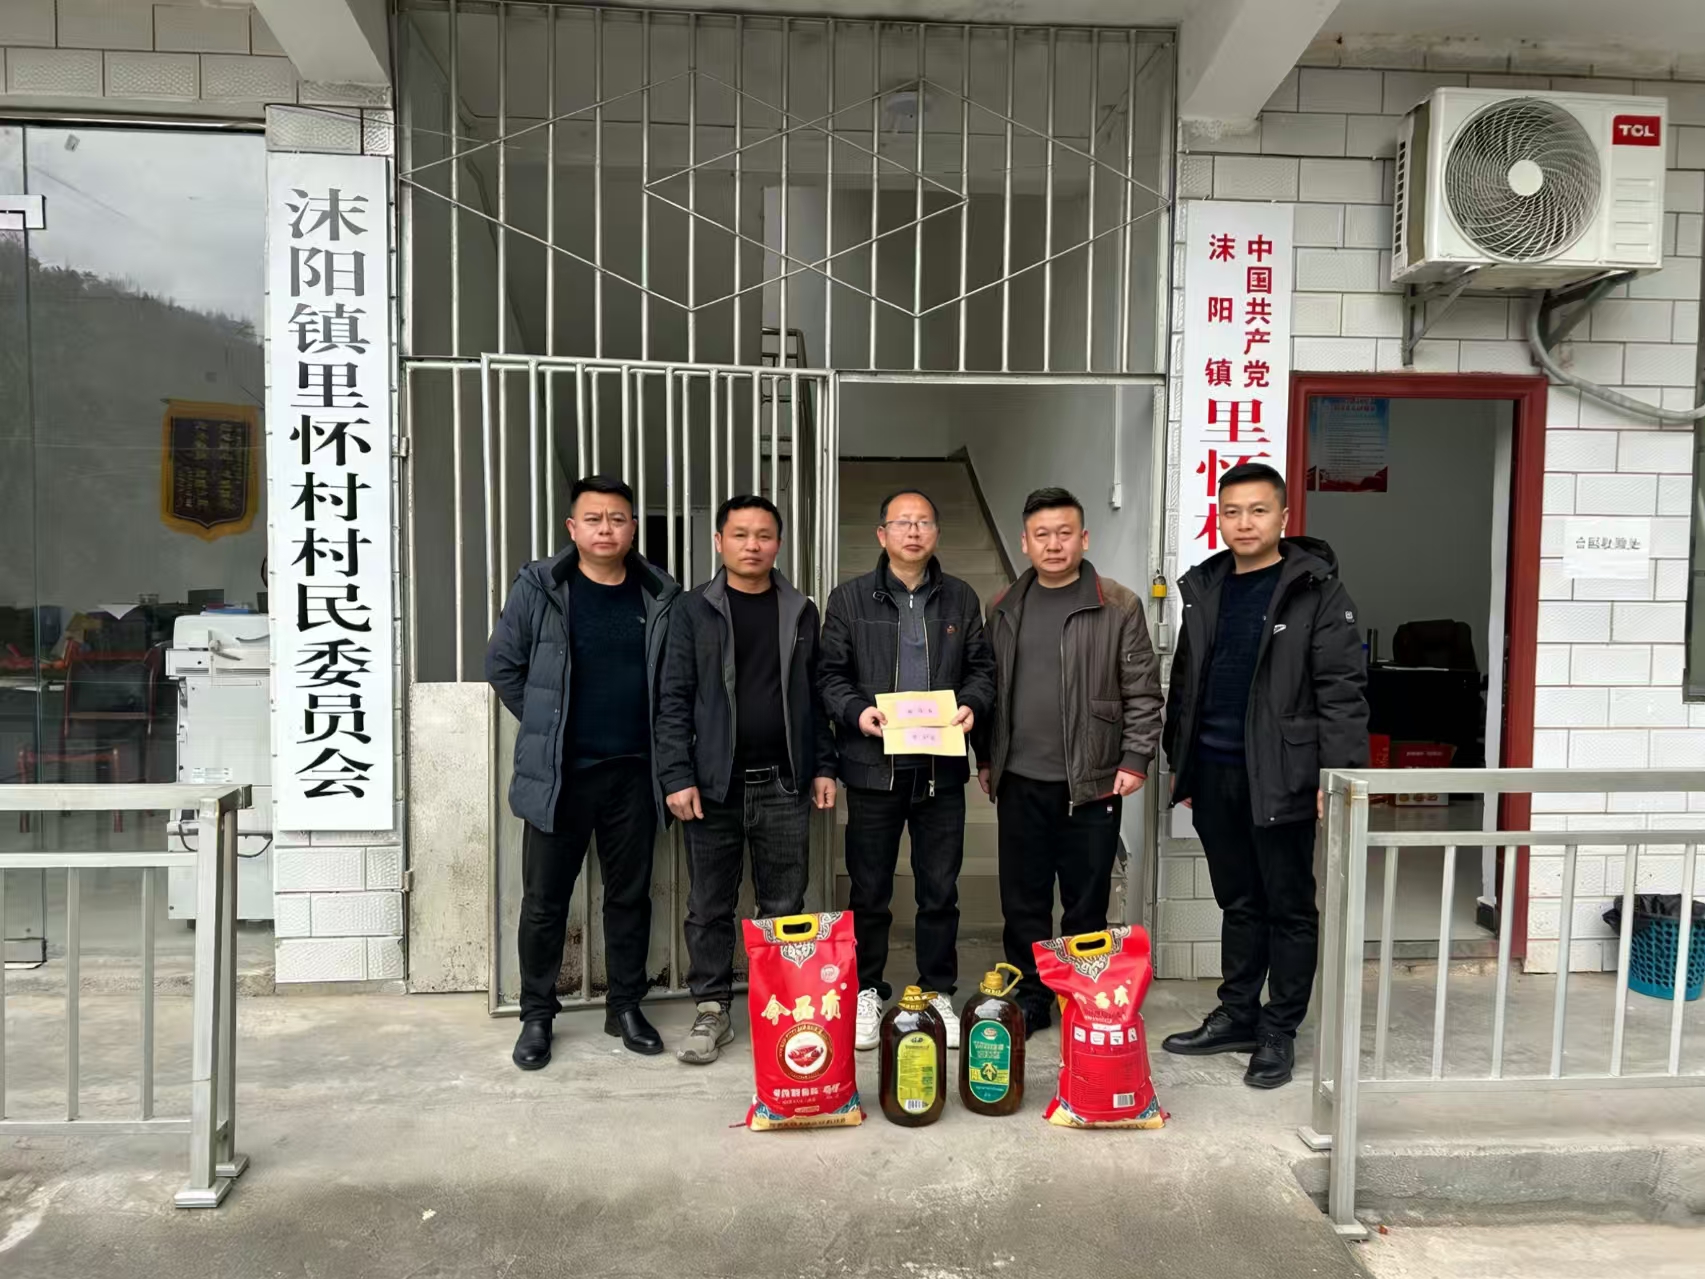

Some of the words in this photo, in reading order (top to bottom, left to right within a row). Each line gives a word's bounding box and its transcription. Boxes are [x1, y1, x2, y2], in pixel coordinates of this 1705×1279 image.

[1618, 124, 1656, 137] TCL
[1205, 233, 1236, 387] 沫阳镇
[1243, 234, 1273, 388] 中国共产党
[285, 188, 374, 798] 沫阳镇里怀村村民委员会
